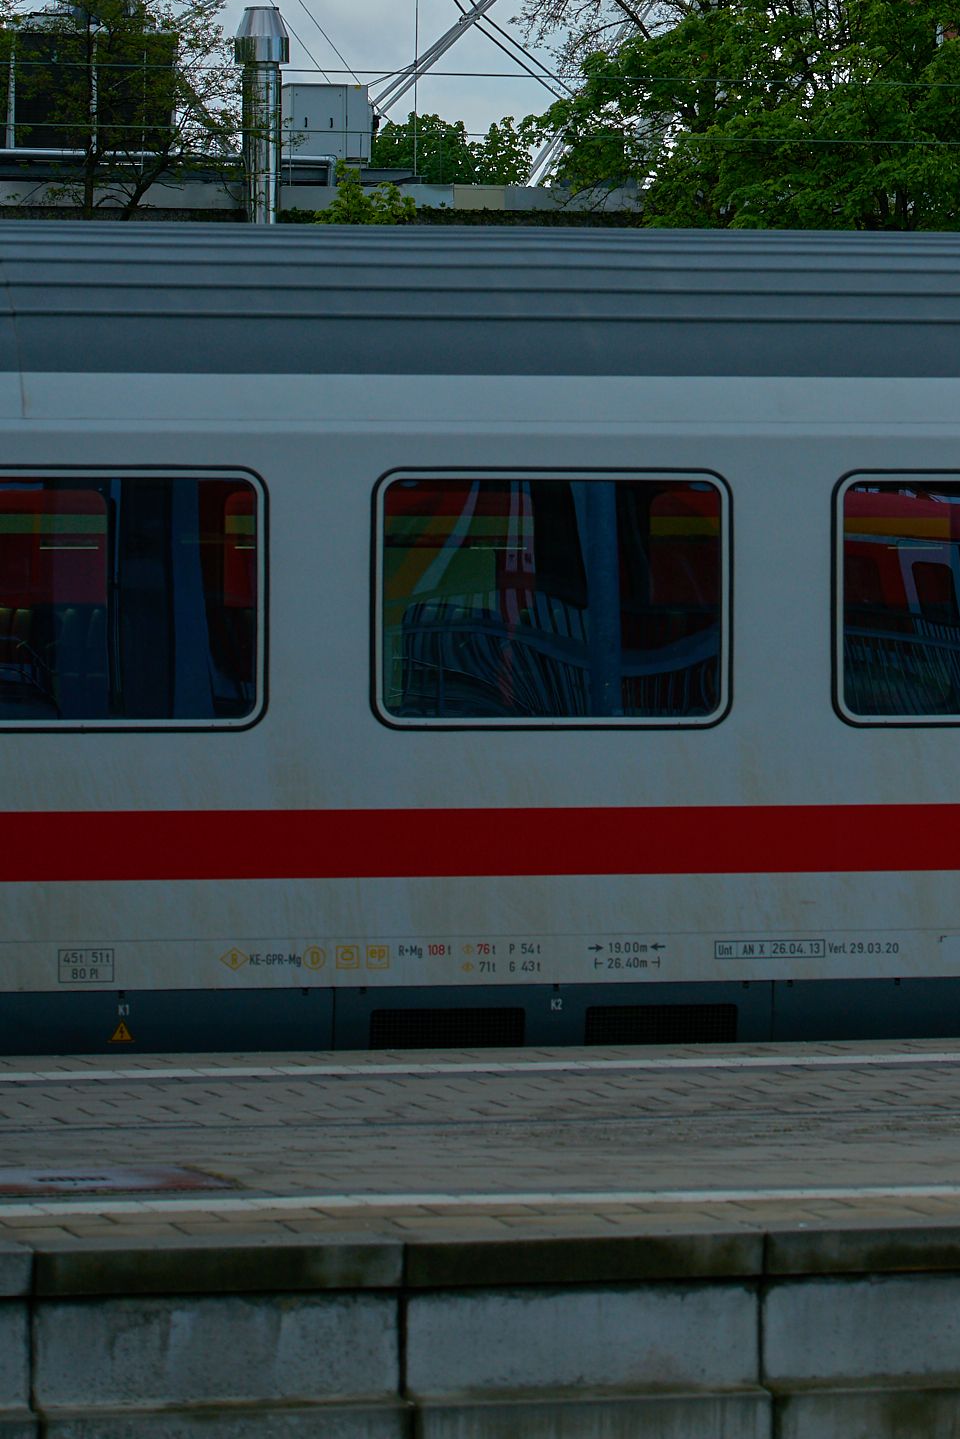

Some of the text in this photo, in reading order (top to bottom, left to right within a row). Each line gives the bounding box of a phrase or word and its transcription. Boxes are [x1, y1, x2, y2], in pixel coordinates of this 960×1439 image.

[428, 944, 445, 955] 108
[718, 944, 733, 956] Unt
[742, 943, 754, 955] AN
[758, 943, 765, 954] X
[850, 942, 899, 954] 29.03.20
[249, 953, 302, 967] KE-GPR-Mg
[311, 951, 320, 965] D
[71, 968, 86, 980] 80
[118, 1003, 130, 1016] K1
[550, 998, 563, 1011] K2
